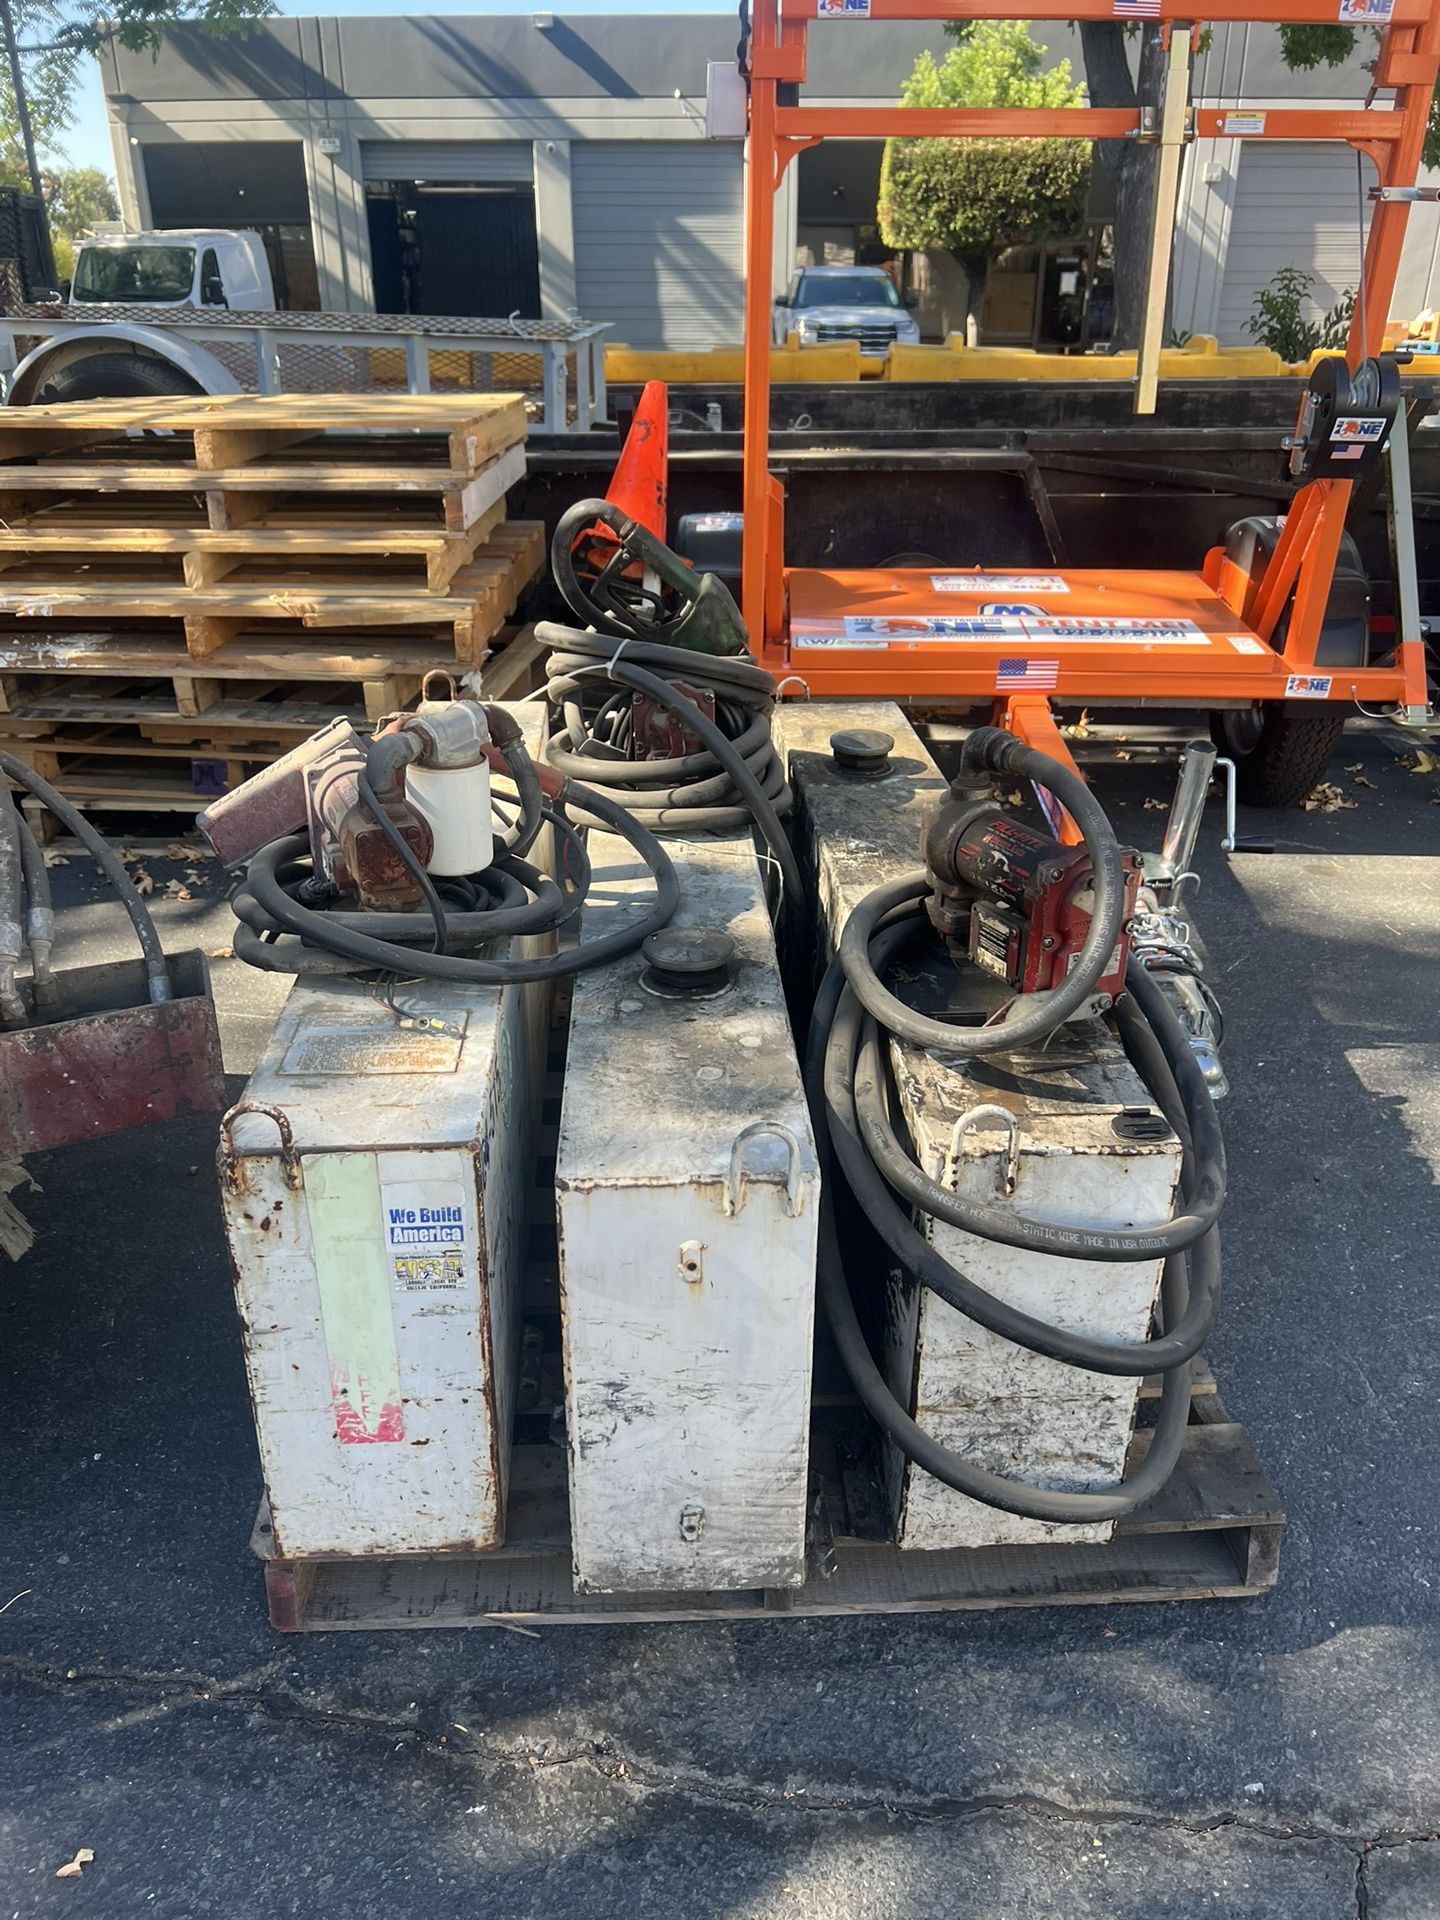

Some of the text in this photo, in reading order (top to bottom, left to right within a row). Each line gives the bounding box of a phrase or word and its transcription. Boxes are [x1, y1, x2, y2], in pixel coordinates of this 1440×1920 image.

[1036, 619, 1120, 628] RENT
[1095, 906, 1113, 936] STATIC
[1087, 935, 1106, 959] WITH
[389, 1206, 462, 1223] We Build
[925, 1184, 967, 1214] TRANSFER
[1021, 1223, 1056, 1239] STATIC
[1056, 1230, 1081, 1244] WIRE
[1081, 1234, 1105, 1247] MADE
[1108, 1238, 1118, 1248] IN
[1121, 1238, 1137, 1249] USA
[392, 1226, 462, 1243] America
